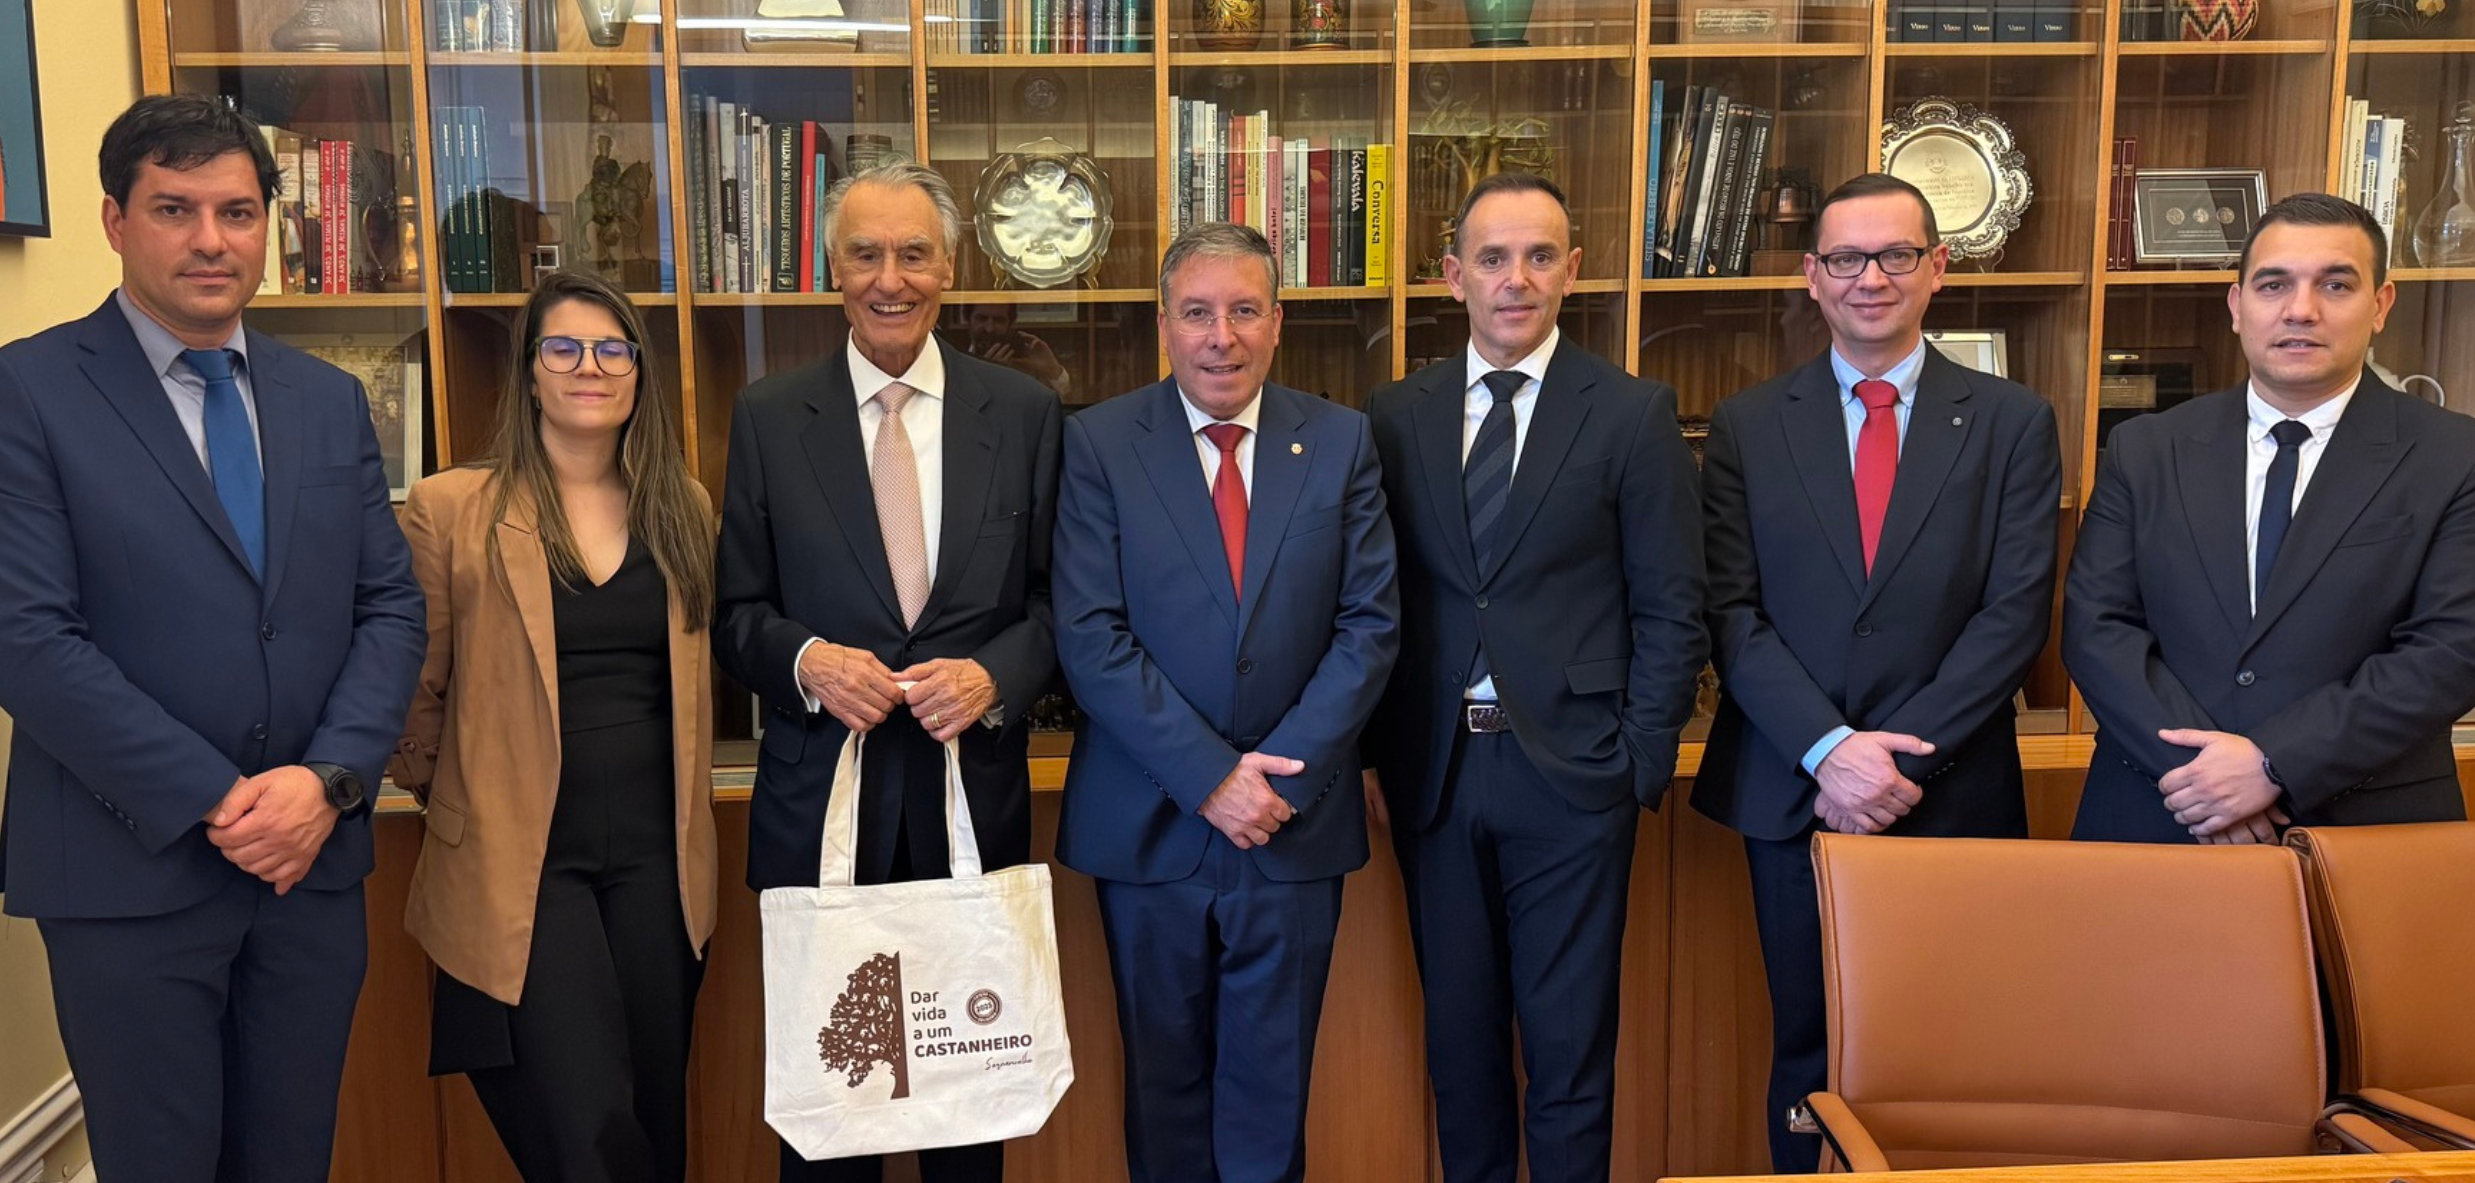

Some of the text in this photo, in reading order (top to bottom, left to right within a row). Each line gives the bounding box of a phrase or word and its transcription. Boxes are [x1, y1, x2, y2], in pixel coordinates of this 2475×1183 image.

[780, 127, 791, 270] TESOUROS ARTÍSTICOS DE PORTUGAL
[741, 189, 751, 251] ALJUBARROTA
[1371, 180, 1384, 245] Conversa
[911, 991, 939, 1004] Dar
[912, 1007, 947, 1022] vida
[913, 1026, 952, 1040] a um
[914, 1034, 1033, 1058] CASTANHEIRO
